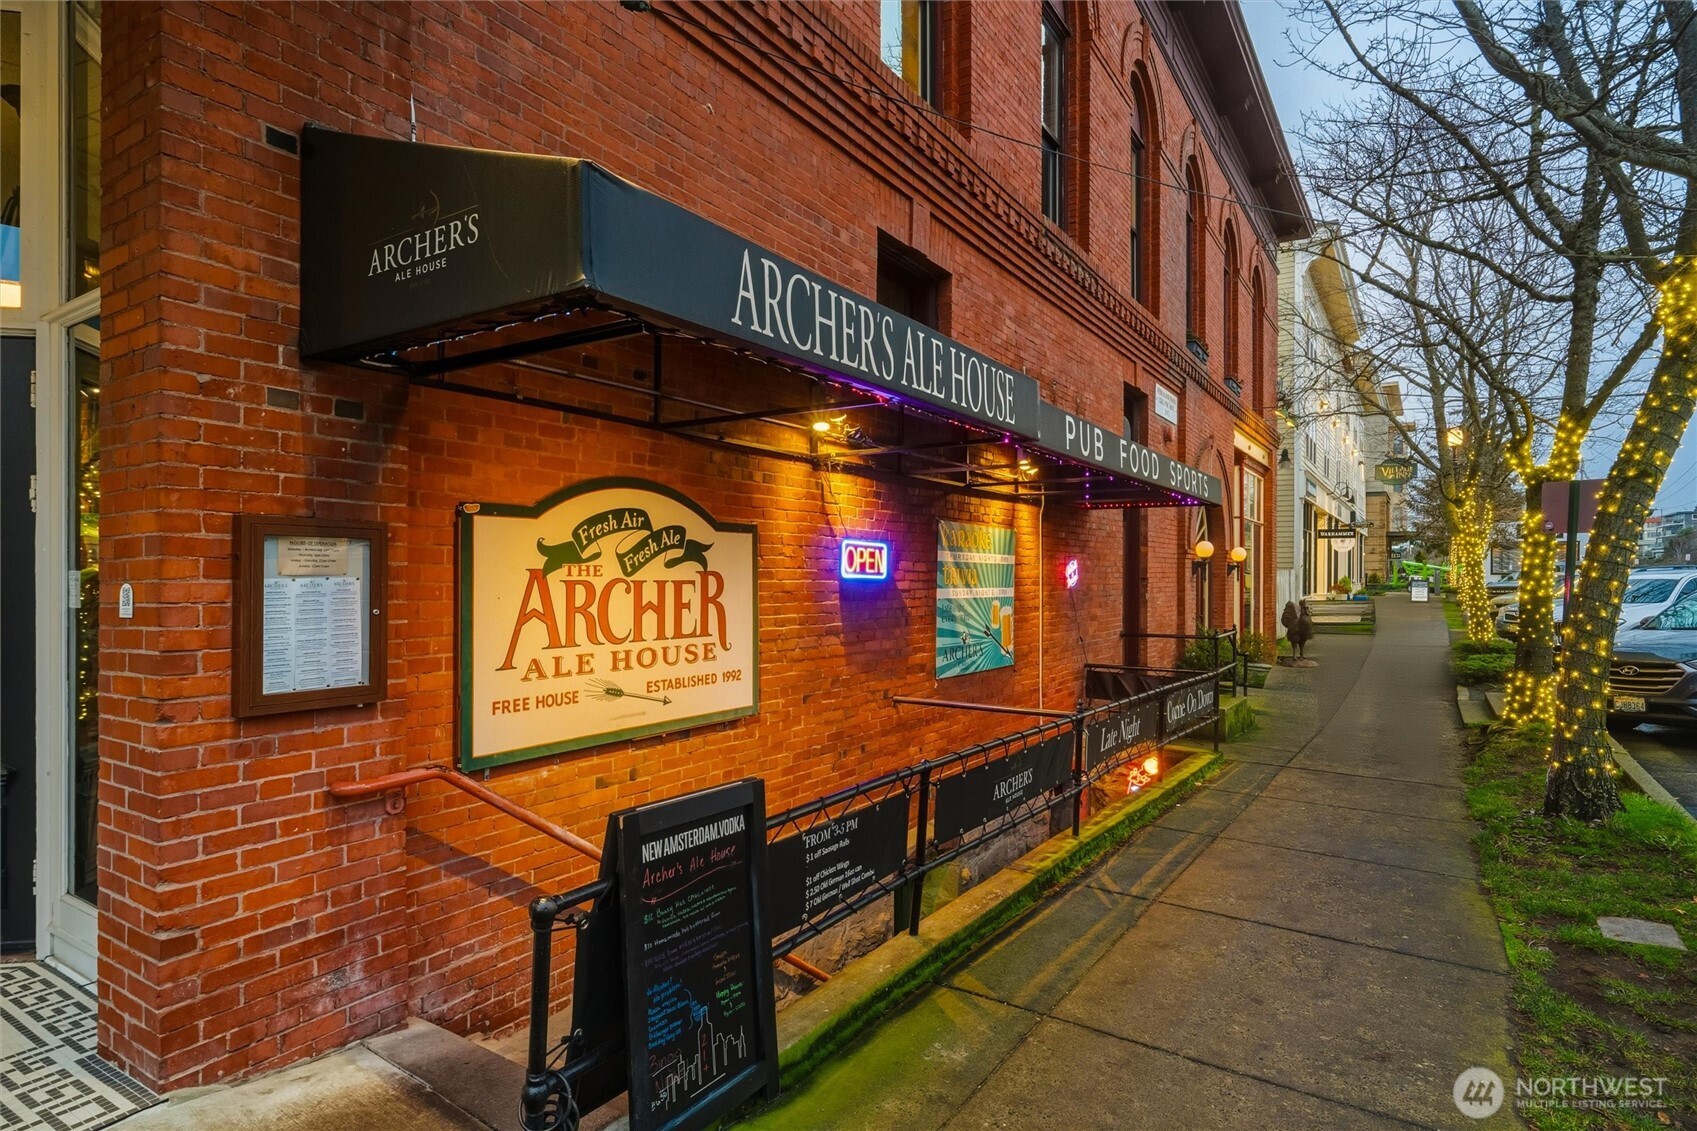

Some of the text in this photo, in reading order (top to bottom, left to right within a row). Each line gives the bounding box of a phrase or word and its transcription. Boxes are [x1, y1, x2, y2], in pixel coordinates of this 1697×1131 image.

[367, 213, 479, 277] ARCHER'S
[394, 257, 447, 282] ALE HOUSE
[731, 248, 1016, 425] ARCHER'S ALE HOUSE
[1065, 414, 1209, 498] PUB FOOD SPORTS
[577, 510, 645, 547] Fresh Air
[623, 530, 681, 573] Fresh Ale
[844, 545, 886, 574] OPEN
[563, 564, 604, 577] THE
[494, 568, 732, 671] ARCHER
[520, 642, 718, 681] ALE HOUSE
[646, 669, 742, 694] ESTABLISHED 1992
[491, 690, 580, 716] FREE HOUSE
[1166, 689, 1214, 723] Come On Down
[1100, 715, 1141, 752] Late Night
[805, 817, 859, 849] FROM 3-5 PM
[642, 840, 664, 864] NEW
[642, 845, 736, 888] Archer's Ale House
[814, 848, 822, 860] off
[822, 843, 839, 856] Sausage
[813, 871, 821, 882] off
[820, 865, 837, 879] Chicken
[836, 860, 850, 871] Wings
[820, 880, 828, 890] Old
[828, 874, 844, 886] German
[855, 864, 863, 873] can
[813, 895, 822, 906] Old
[822, 888, 838, 901] German
[841, 880, 851, 891] Well
[851, 875, 861, 886] Shot
